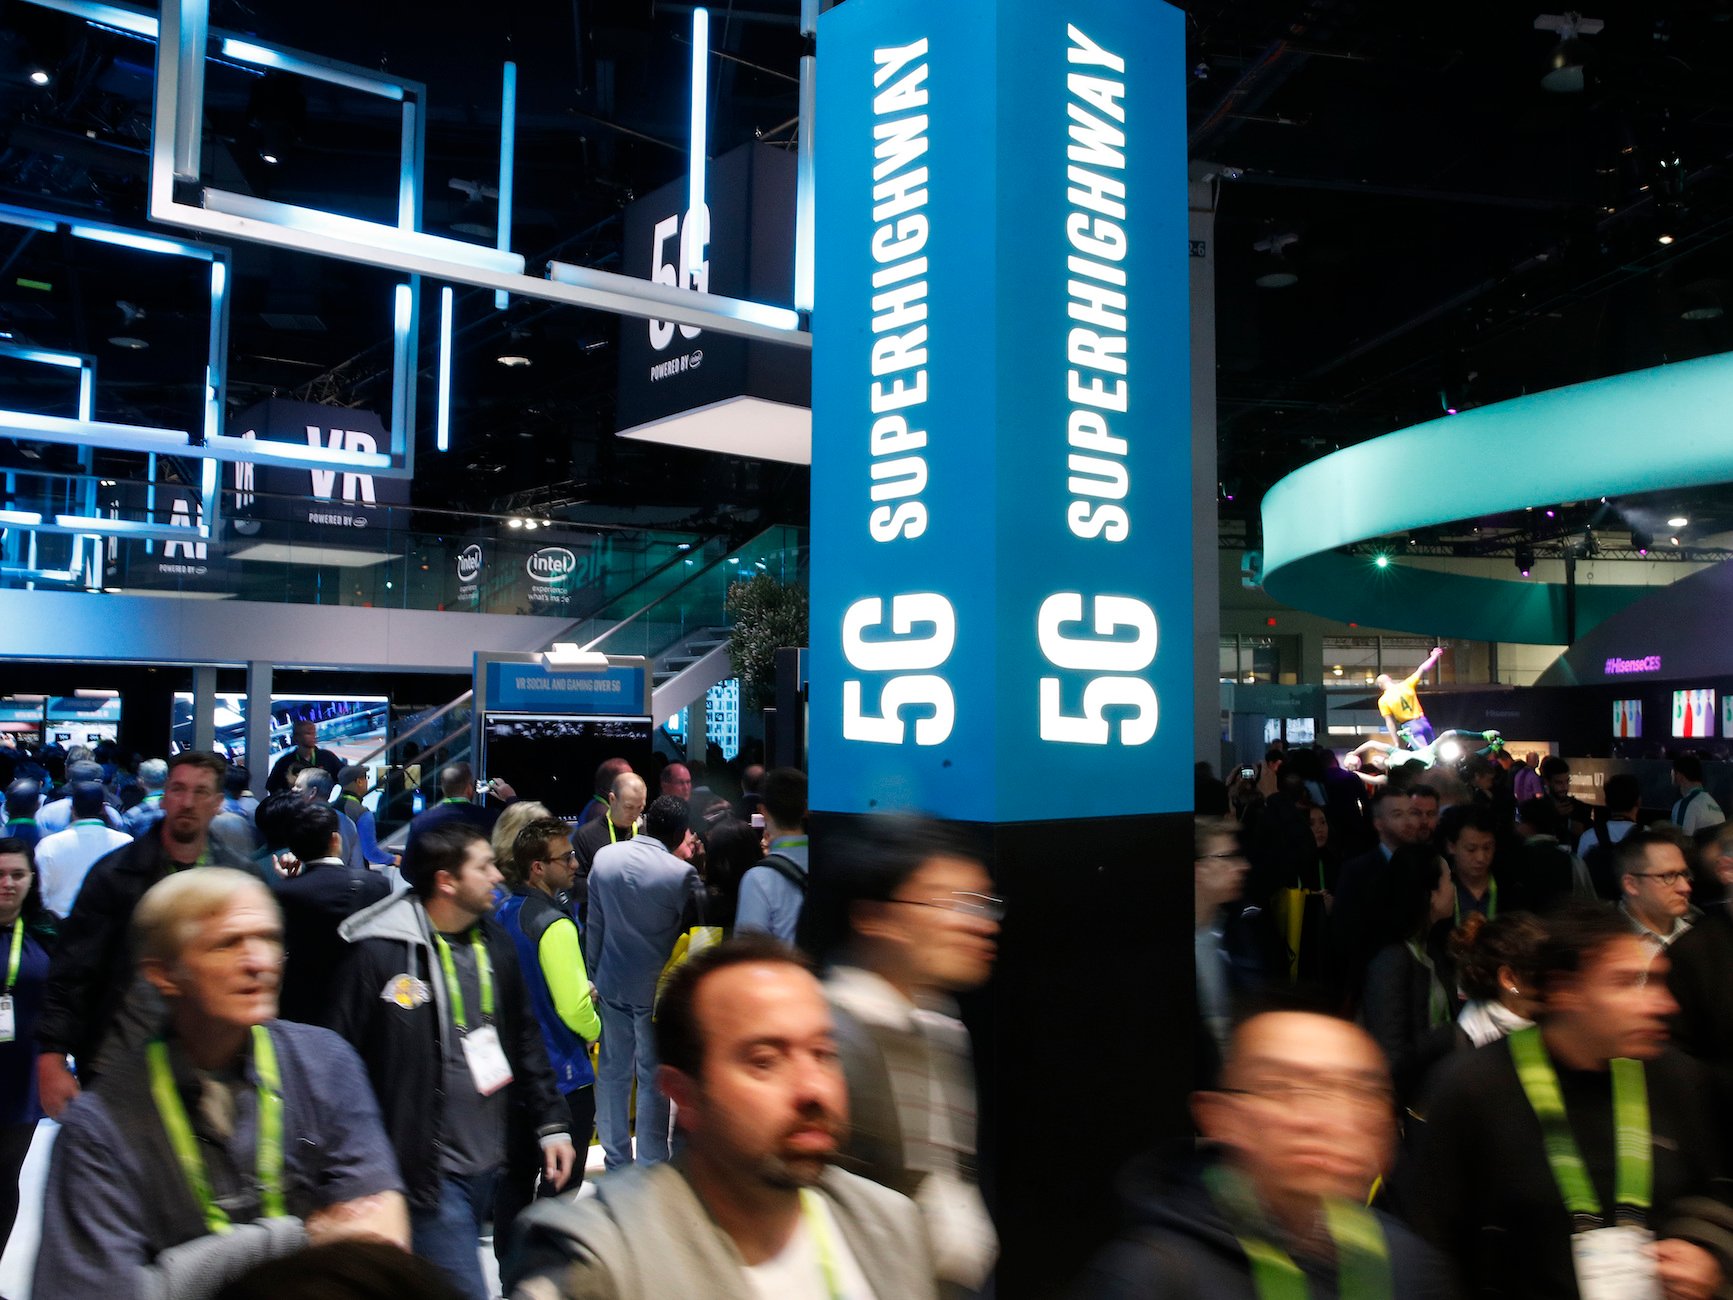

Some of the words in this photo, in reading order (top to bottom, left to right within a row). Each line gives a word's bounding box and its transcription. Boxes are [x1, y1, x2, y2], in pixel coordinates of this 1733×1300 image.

[649, 203, 711, 350] 5G
[869, 37, 929, 543] SUPERHIGHWAY
[1066, 23, 1130, 543] SUPERHIGHWAY
[650, 358, 680, 382] POWERED
[681, 354, 690, 371] BY
[306, 425, 378, 508] VR
[309, 513, 342, 526] POWERED
[343, 516, 353, 527] BY
[533, 553, 570, 573] intel
[515, 677, 526, 690] VR
[527, 678, 551, 690] SOCIAL
[551, 679, 566, 691] AND
[566, 679, 593, 692] GAMING
[594, 680, 612, 692] OVER
[842, 592, 956, 746] 5G
[1037, 592, 1159, 746] 5G
[1604, 655, 1661, 674] #HisenseCES
[1400, 696, 1413, 712] 4
